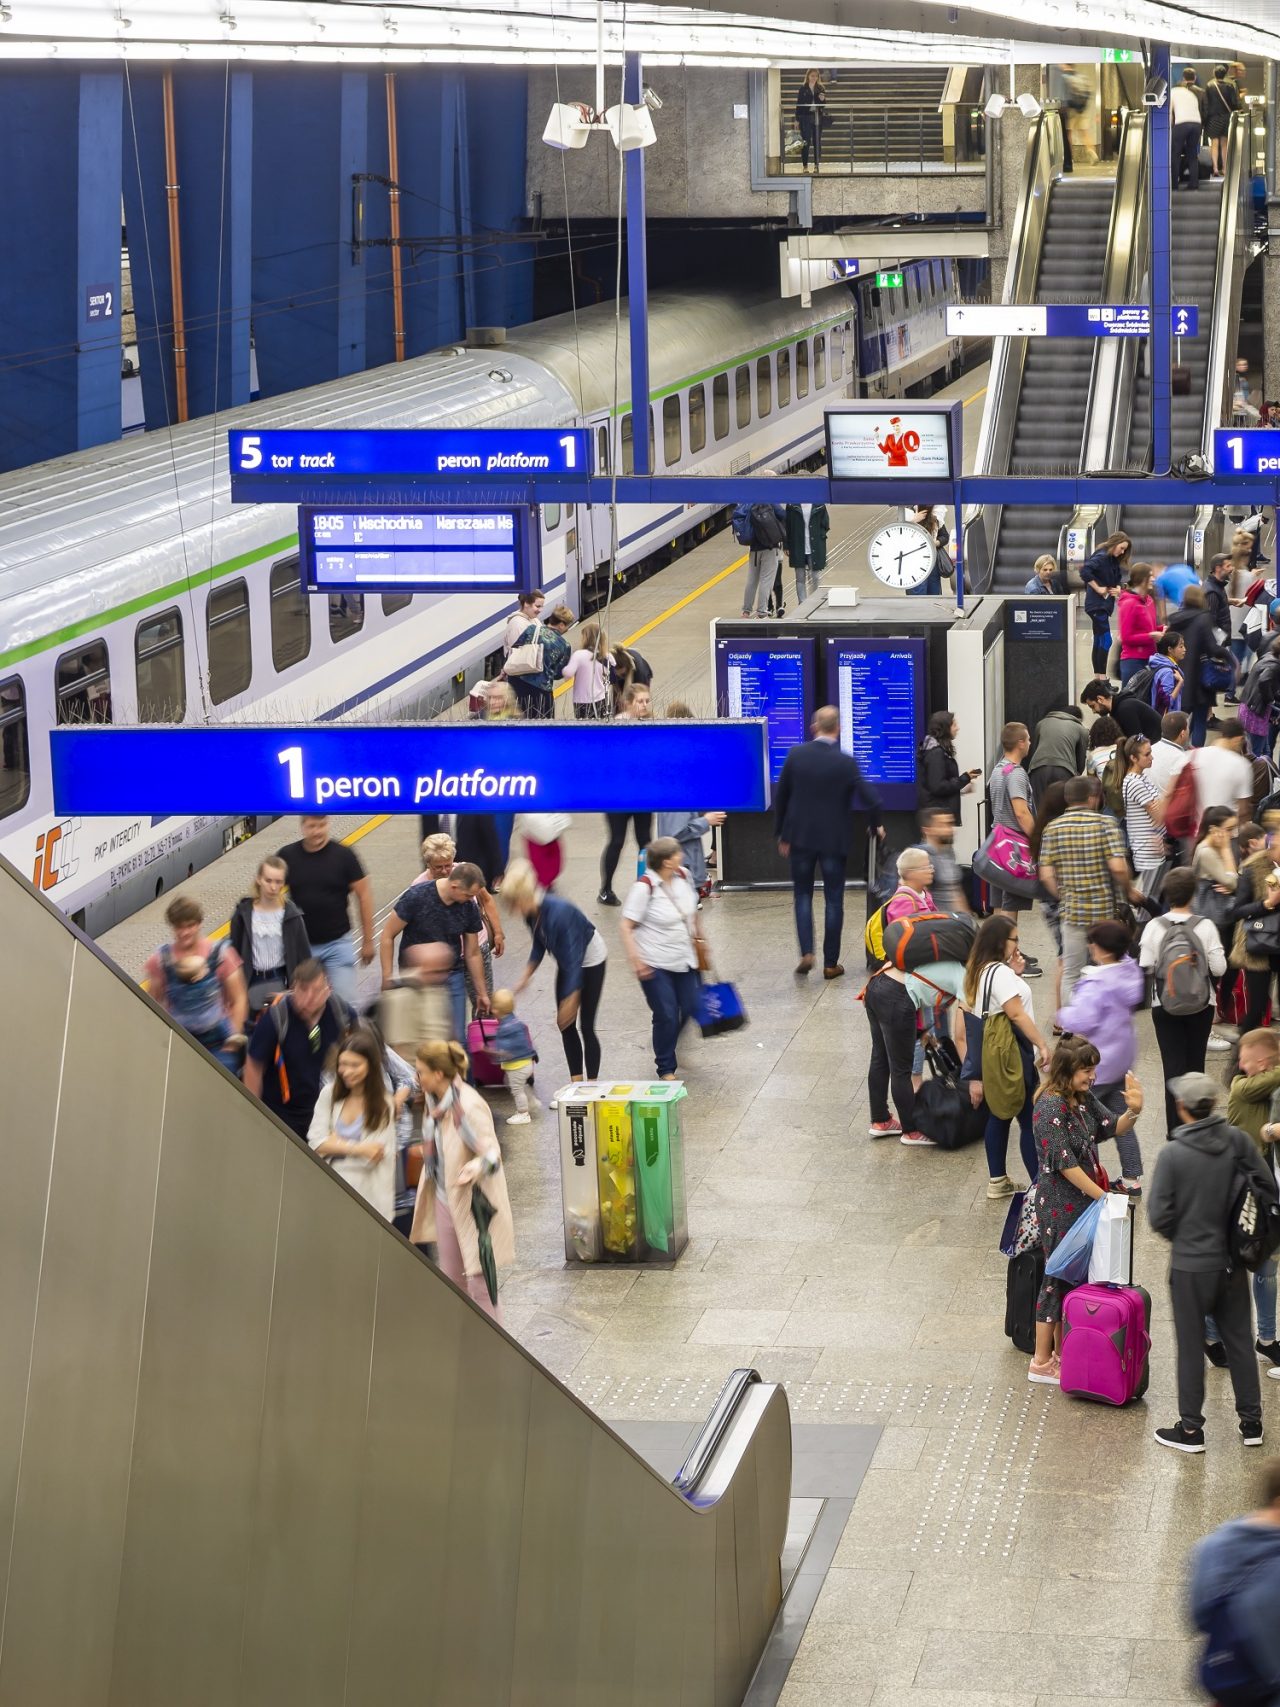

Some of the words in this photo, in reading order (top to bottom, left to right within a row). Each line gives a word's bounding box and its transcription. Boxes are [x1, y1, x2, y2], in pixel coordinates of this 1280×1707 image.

[105, 292, 112, 316] 2
[241, 436, 263, 469] 5
[271, 454, 293, 469] tor
[299, 452, 336, 468] track
[437, 455, 481, 471] peron
[487, 452, 549, 471] platform
[559, 435, 576, 468] 1
[1226, 437, 1243, 469] 1
[314, 515, 344, 530] 18:05
[358, 515, 423, 530] Wschodnia
[436, 515, 495, 530] Warszawa
[728, 653, 752, 661] Odjazdy
[278, 747, 305, 799] 1
[315, 776, 401, 804] peron
[415, 769, 537, 804] platform
[94, 841, 107, 862] PKP
[109, 820, 141, 853] INTERCITY
